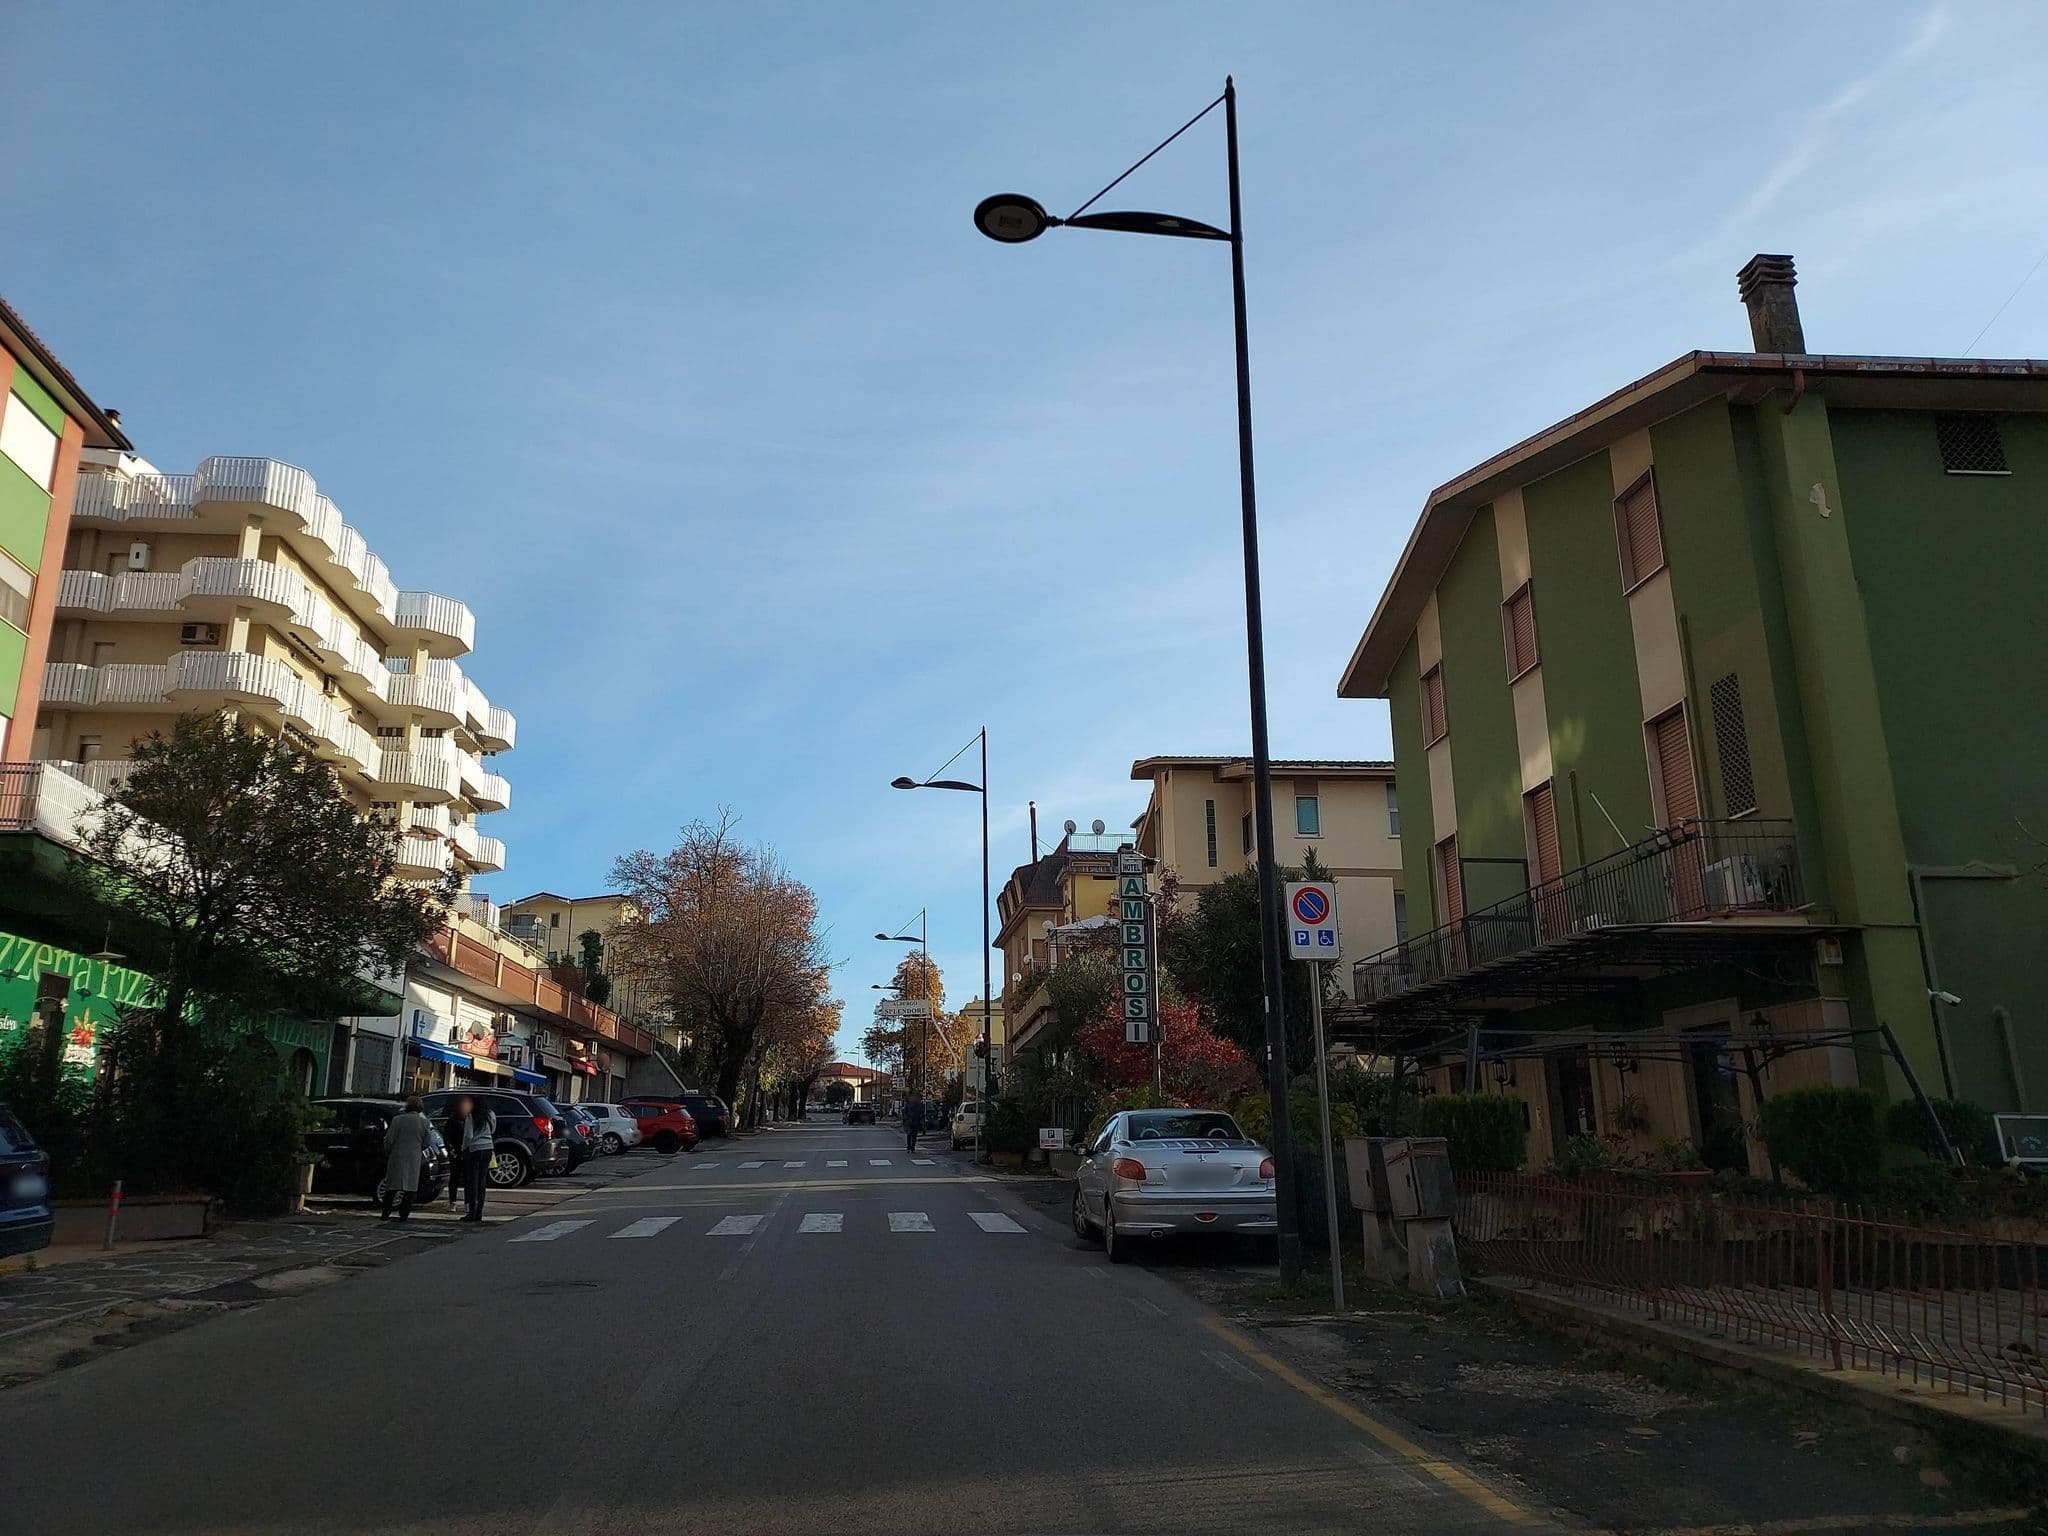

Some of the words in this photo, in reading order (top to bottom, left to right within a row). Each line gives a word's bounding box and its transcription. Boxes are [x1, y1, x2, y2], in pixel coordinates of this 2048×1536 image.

[1122, 863, 1141, 872] HOTEL
[1297, 932, 1306, 944] P
[1124, 878, 1144, 1041] AMBROSI
